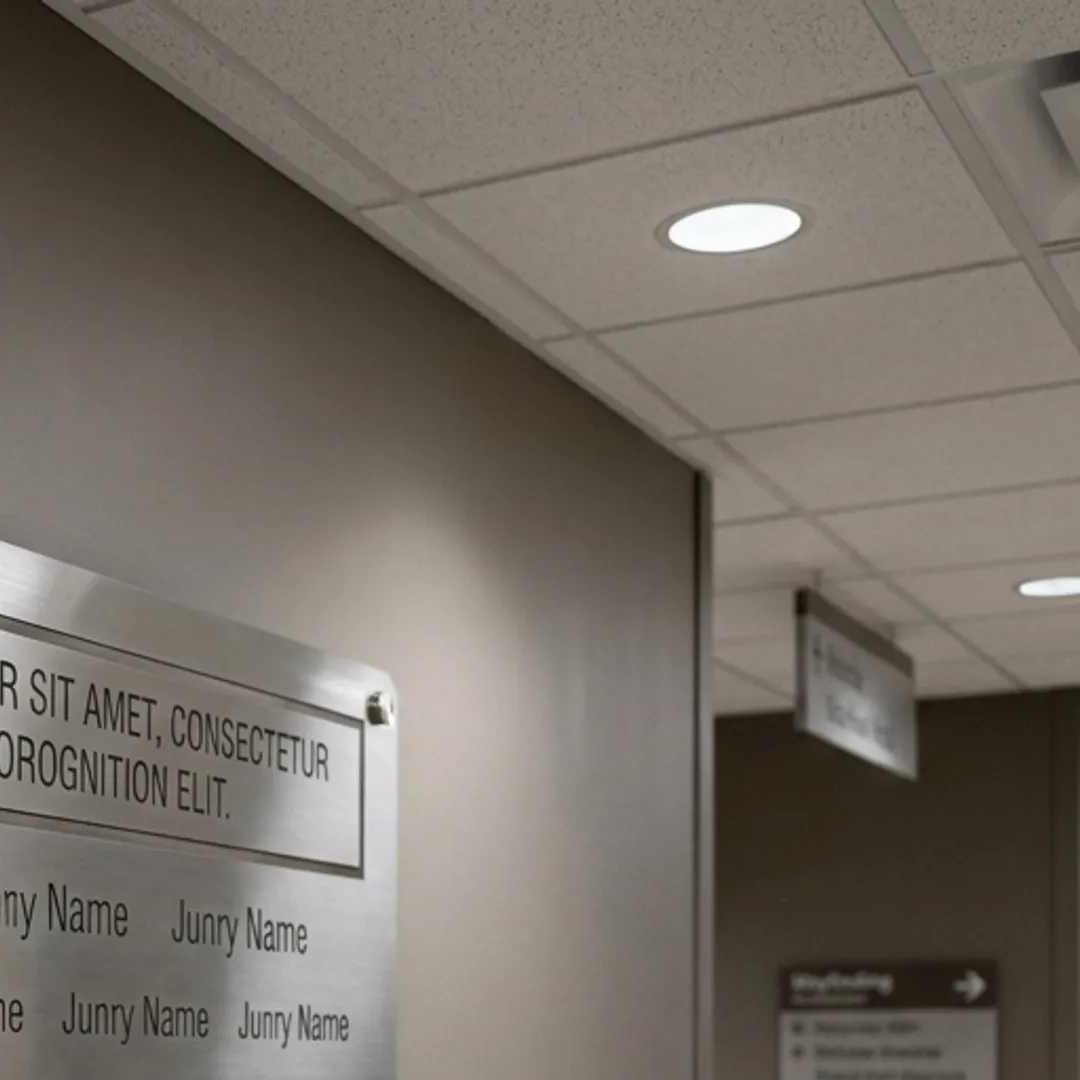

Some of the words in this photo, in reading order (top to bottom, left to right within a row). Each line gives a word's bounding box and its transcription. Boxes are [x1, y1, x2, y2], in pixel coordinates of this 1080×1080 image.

[28, 667, 76, 723] SIT
[82, 682, 162, 749] AMET,
[170, 704, 330, 782] CONSECTETUR
[176, 768, 232, 820] ELIT.
[47, 881, 129, 938] Name
[246, 906, 308, 956] Name
[61, 991, 135, 1046] Junry
[143, 995, 210, 1039] Name
[237, 1000, 293, 1050] Junry
[297, 1003, 350, 1043] Name
